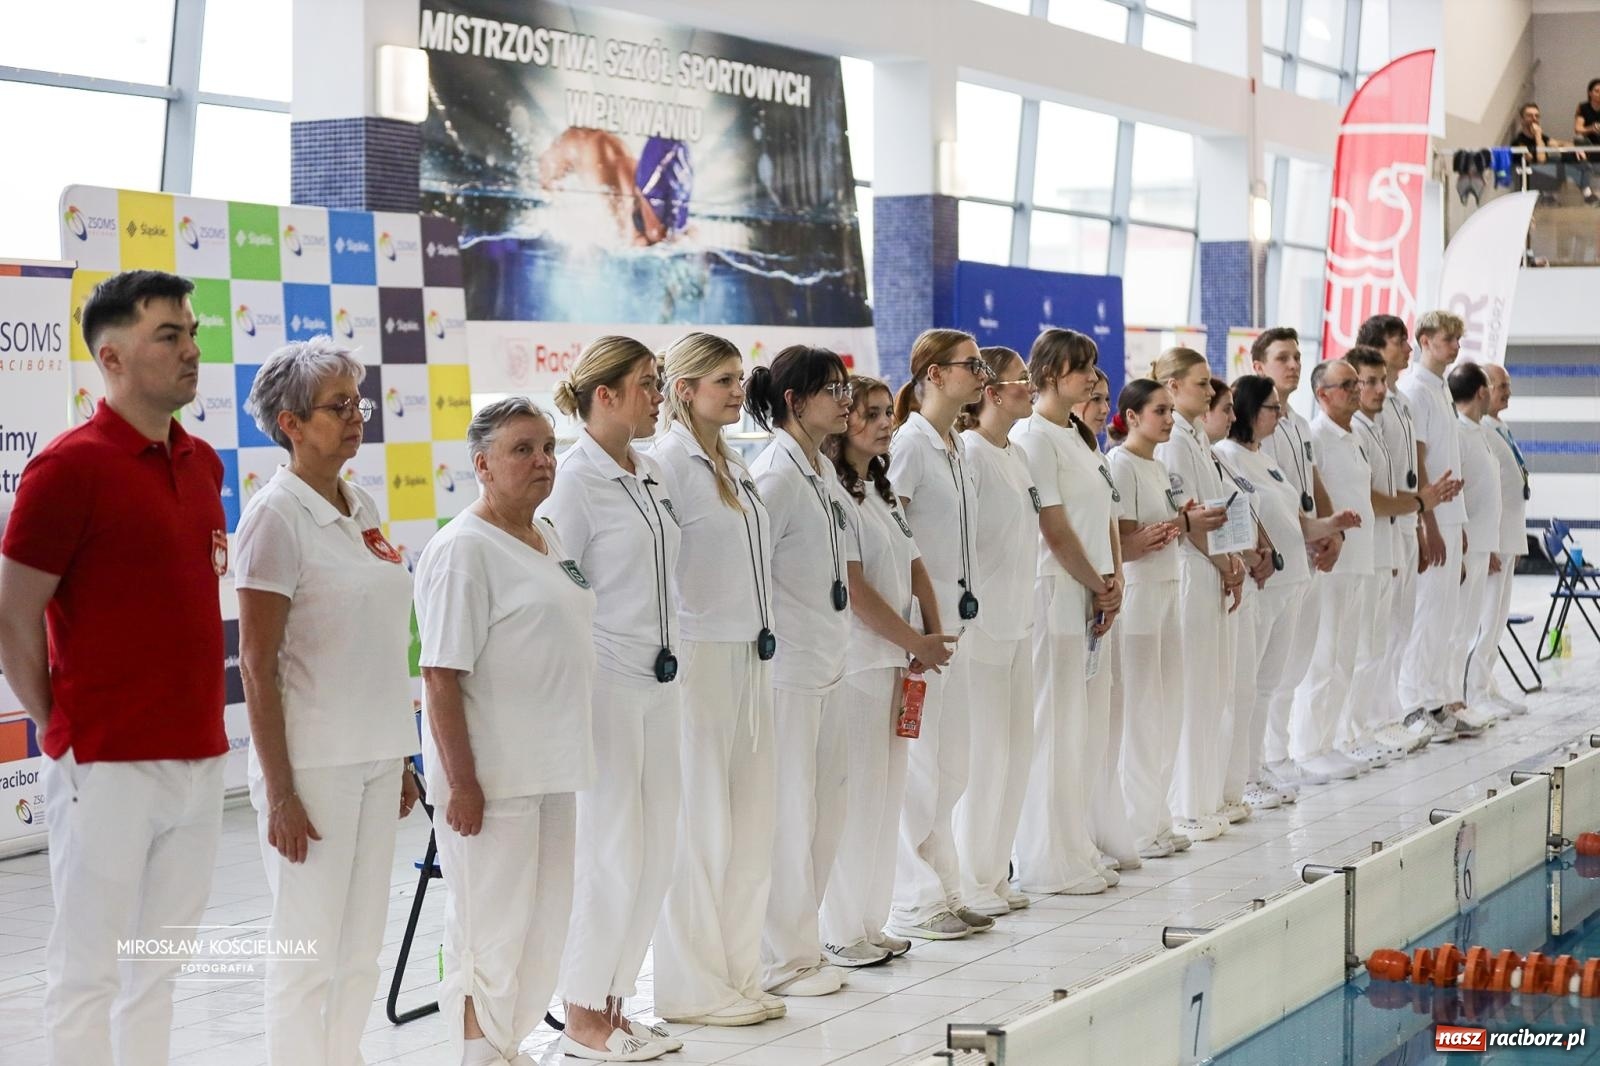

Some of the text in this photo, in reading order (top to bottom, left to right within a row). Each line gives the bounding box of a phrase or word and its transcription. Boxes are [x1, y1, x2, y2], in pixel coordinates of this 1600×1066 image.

[420, 9, 811, 108] MISTRZOSTWA SZKÓŁ SPORTOWYCH
[567, 88, 702, 143] W PŁYWANIU
[88, 216, 116, 231] ZSOMS
[200, 226, 226, 239] ZSOMS
[1463, 849, 1472, 900] 6
